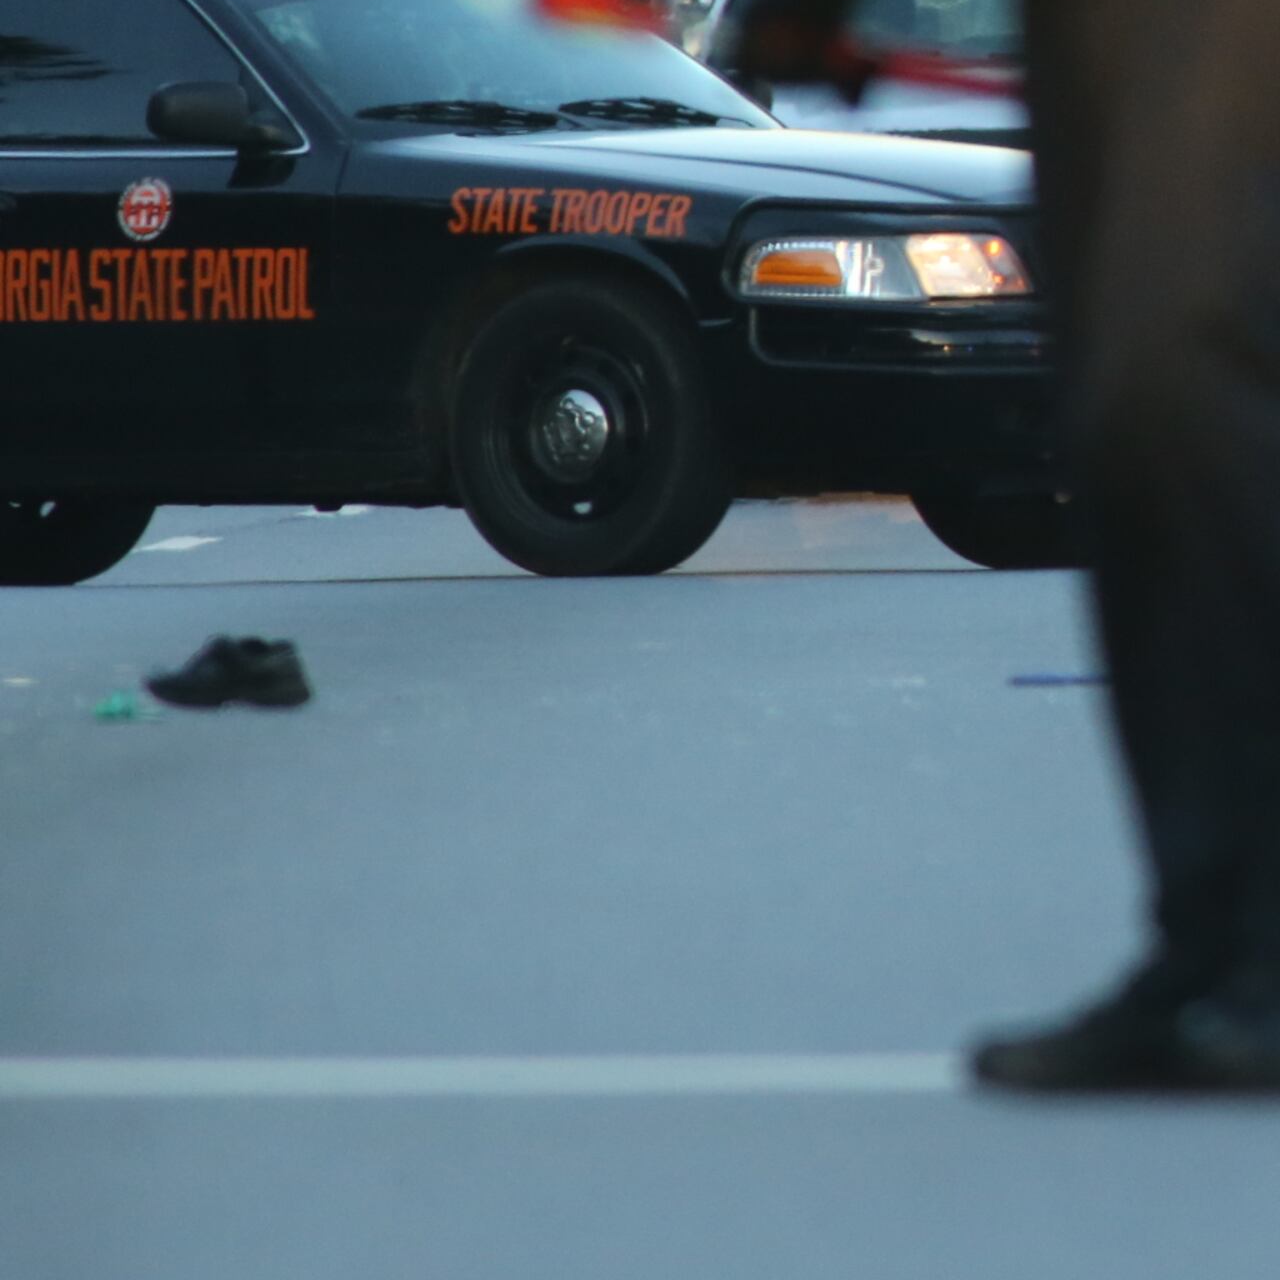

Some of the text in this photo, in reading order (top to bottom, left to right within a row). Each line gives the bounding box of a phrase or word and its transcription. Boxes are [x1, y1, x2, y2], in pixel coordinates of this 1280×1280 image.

[449, 187, 692, 238] STATE TROOPER
[0, 248, 314, 321] RGIA STATE PATROL
